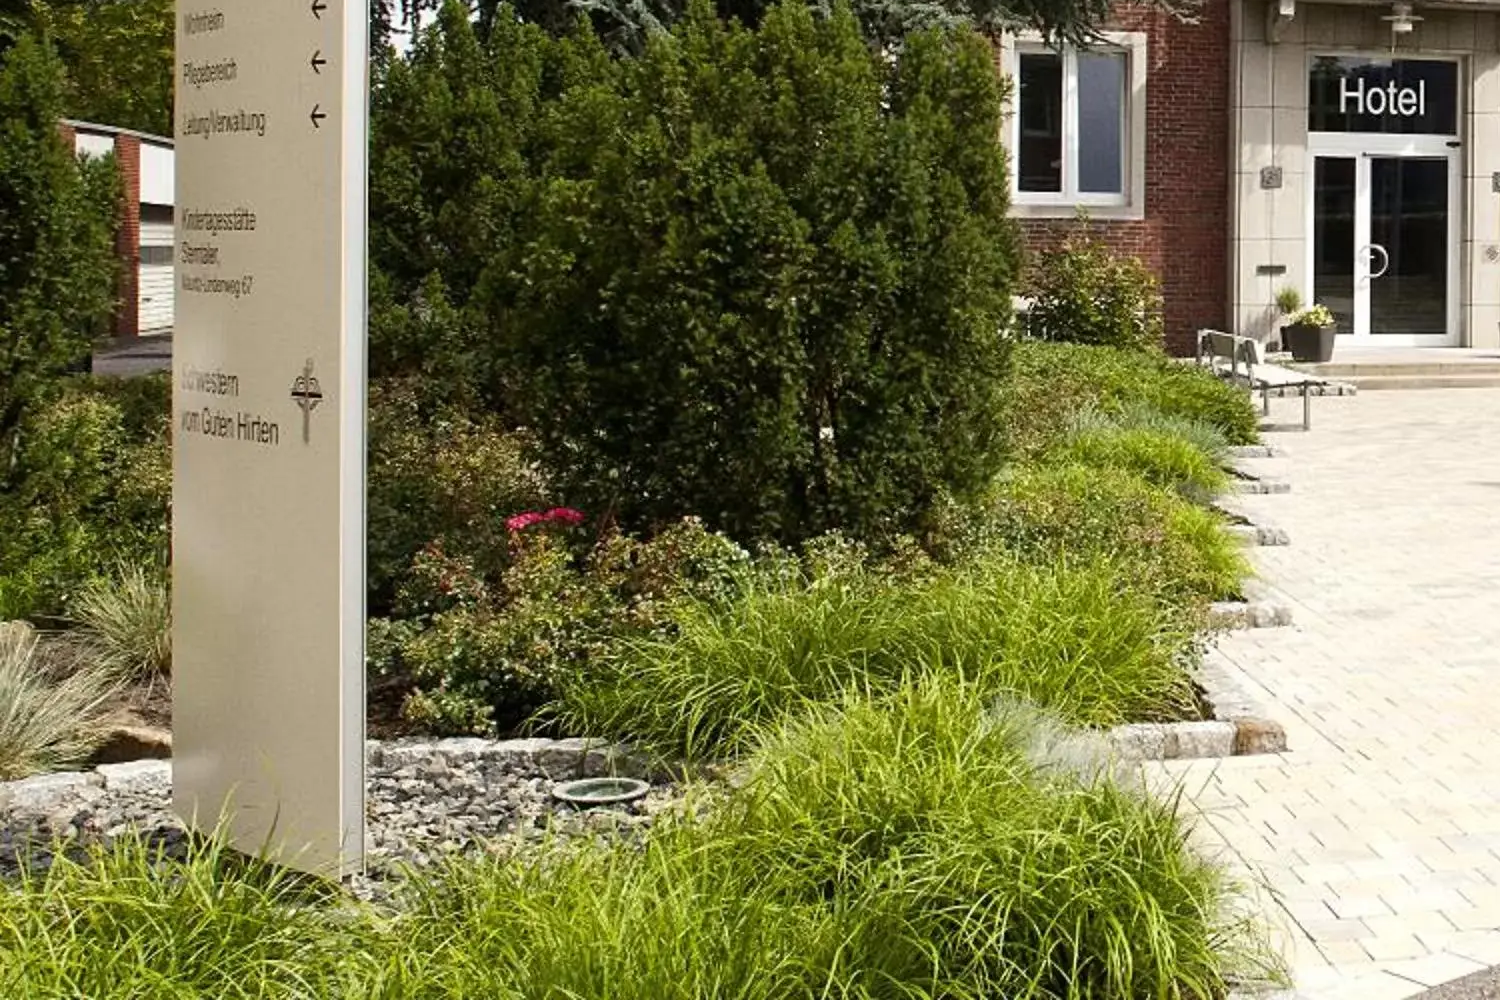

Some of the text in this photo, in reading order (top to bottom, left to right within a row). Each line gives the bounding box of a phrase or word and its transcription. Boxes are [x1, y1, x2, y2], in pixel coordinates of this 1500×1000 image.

[1340, 77, 1425, 116] Hotel
[182, 365, 239, 397] Swestern
[202, 407, 235, 439] Guten
[237, 412, 279, 445] Hirten
